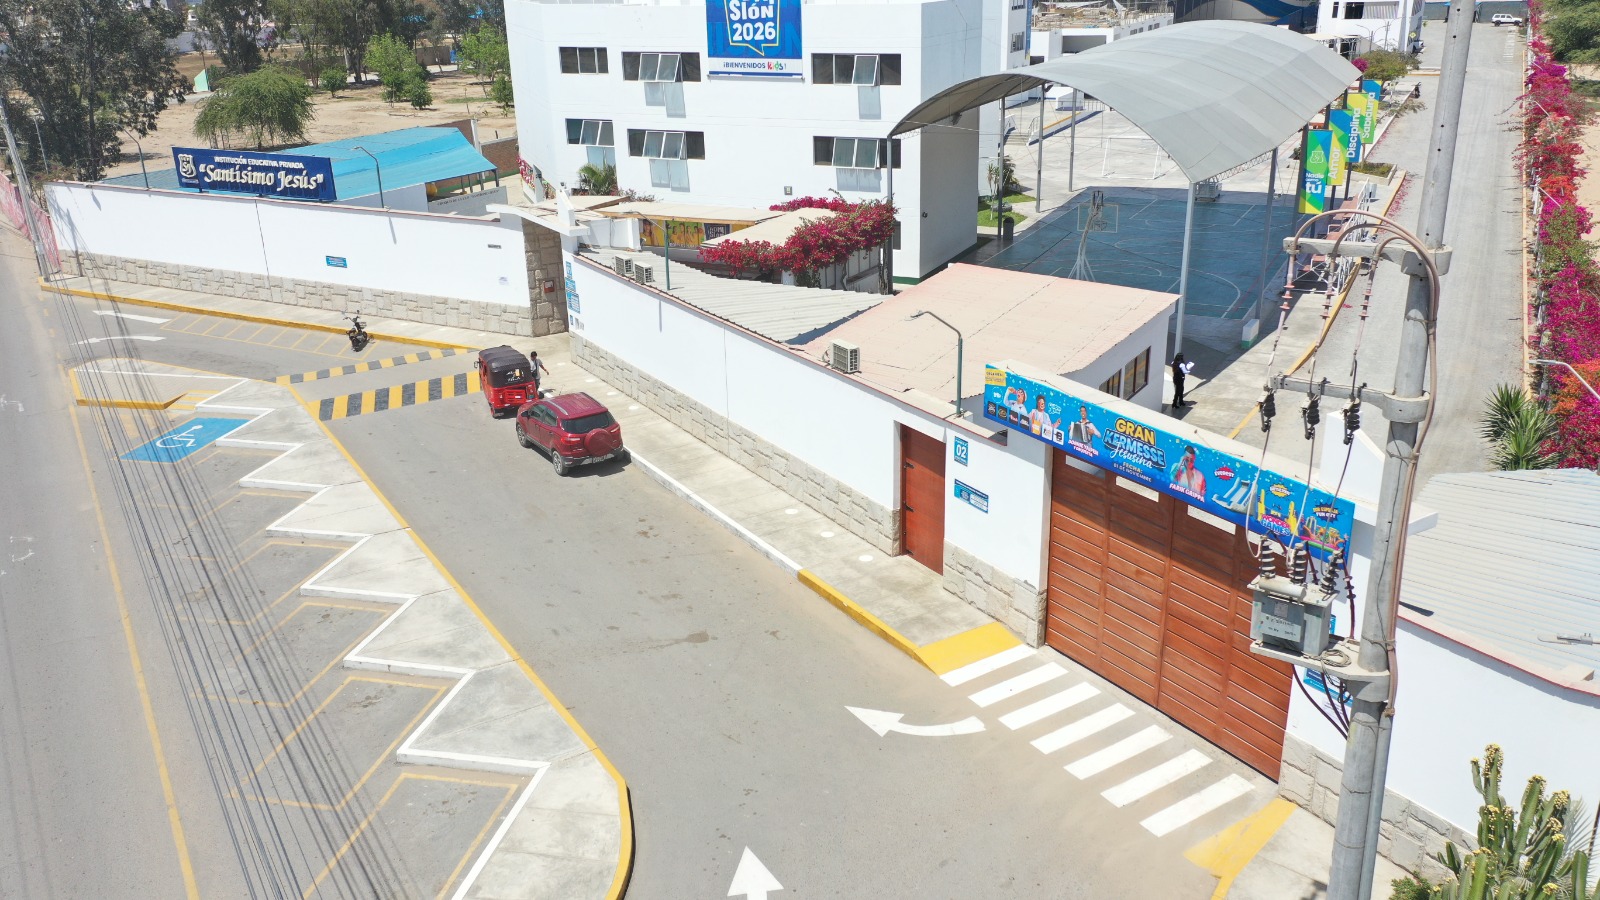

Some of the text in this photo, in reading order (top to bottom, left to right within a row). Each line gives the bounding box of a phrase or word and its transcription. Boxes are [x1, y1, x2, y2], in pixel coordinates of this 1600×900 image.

[733, 22, 776, 41] 2026
[1346, 107, 1361, 158] Disciplina
[214, 155, 305, 169] INSTITUCIÓN EDUCATIVA PRIVADA
[1327, 147, 1341, 180] Amor
[1305, 181, 1323, 194] tú
[1115, 419, 1155, 446] GRAN
[956, 444, 967, 459] 02
[1103, 429, 1165, 466] KERMESSE
[1122, 461, 1143, 474] FECHA:
[1261, 519, 1291, 537] GAMES
